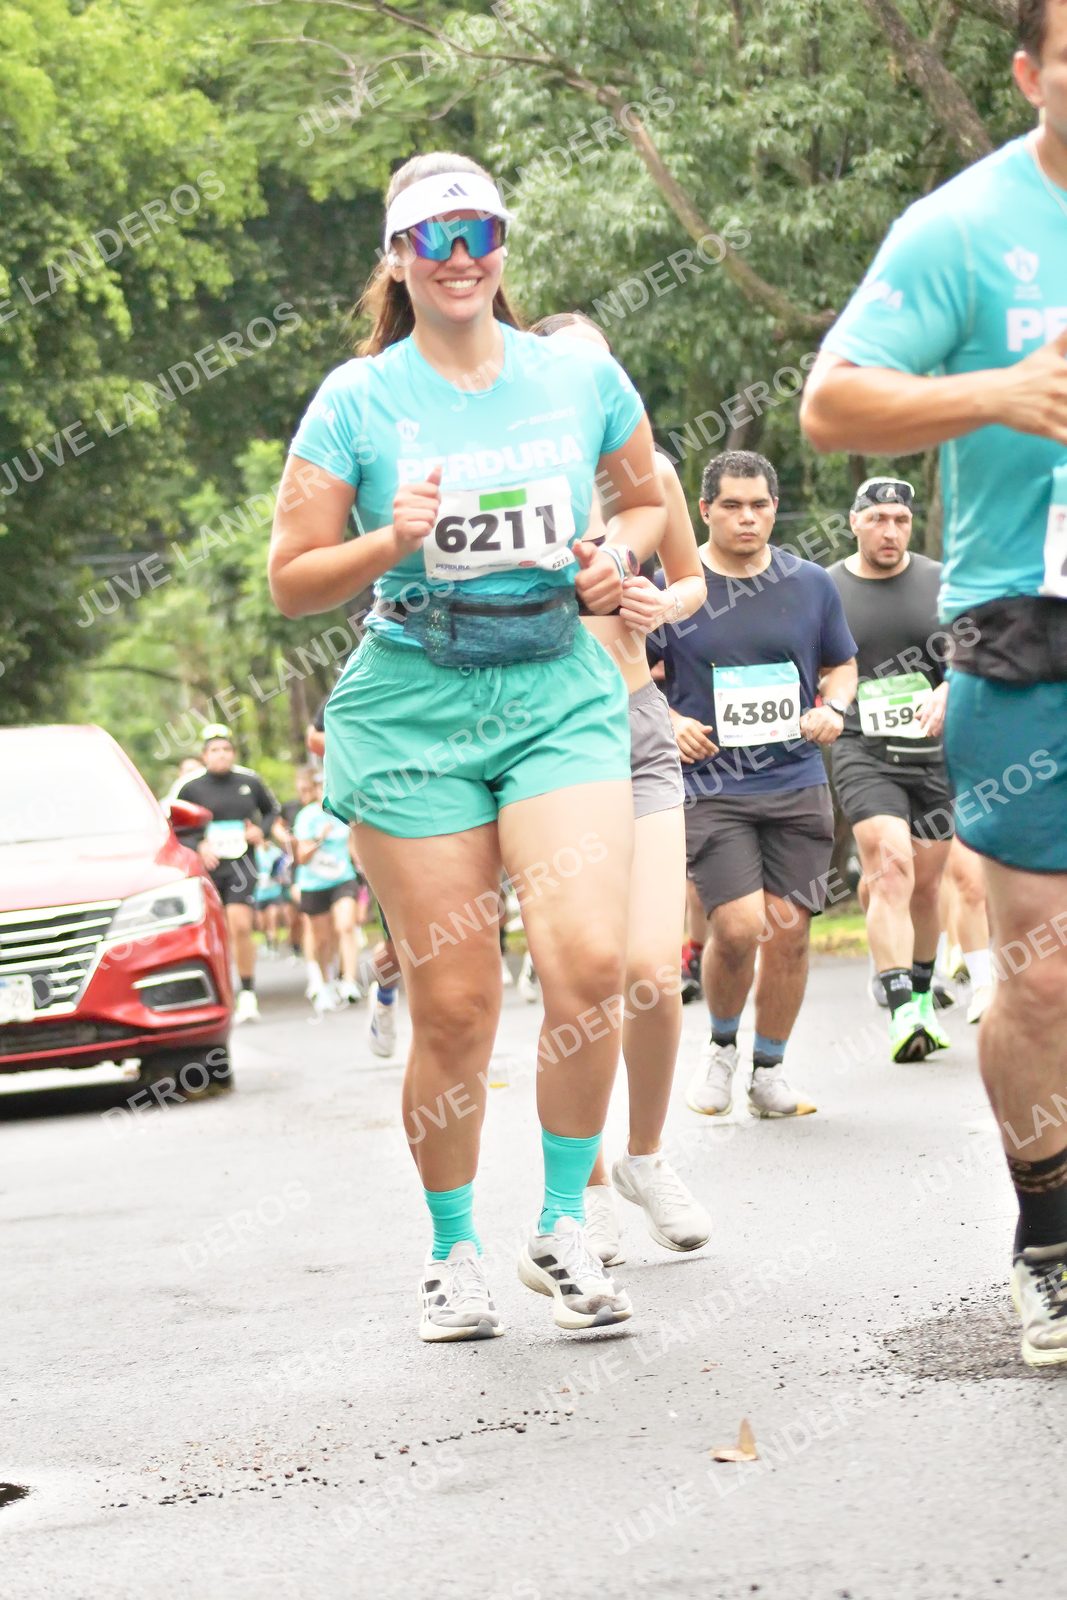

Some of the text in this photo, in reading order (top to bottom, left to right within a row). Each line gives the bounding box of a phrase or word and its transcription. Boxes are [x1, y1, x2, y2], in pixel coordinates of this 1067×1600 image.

[397, 433, 584, 484] PERDURA
[435, 504, 557, 553] 6211
[552, 556, 569, 569] 6211
[723, 698, 794, 726] 4380
[868, 703, 923, 731] 159
